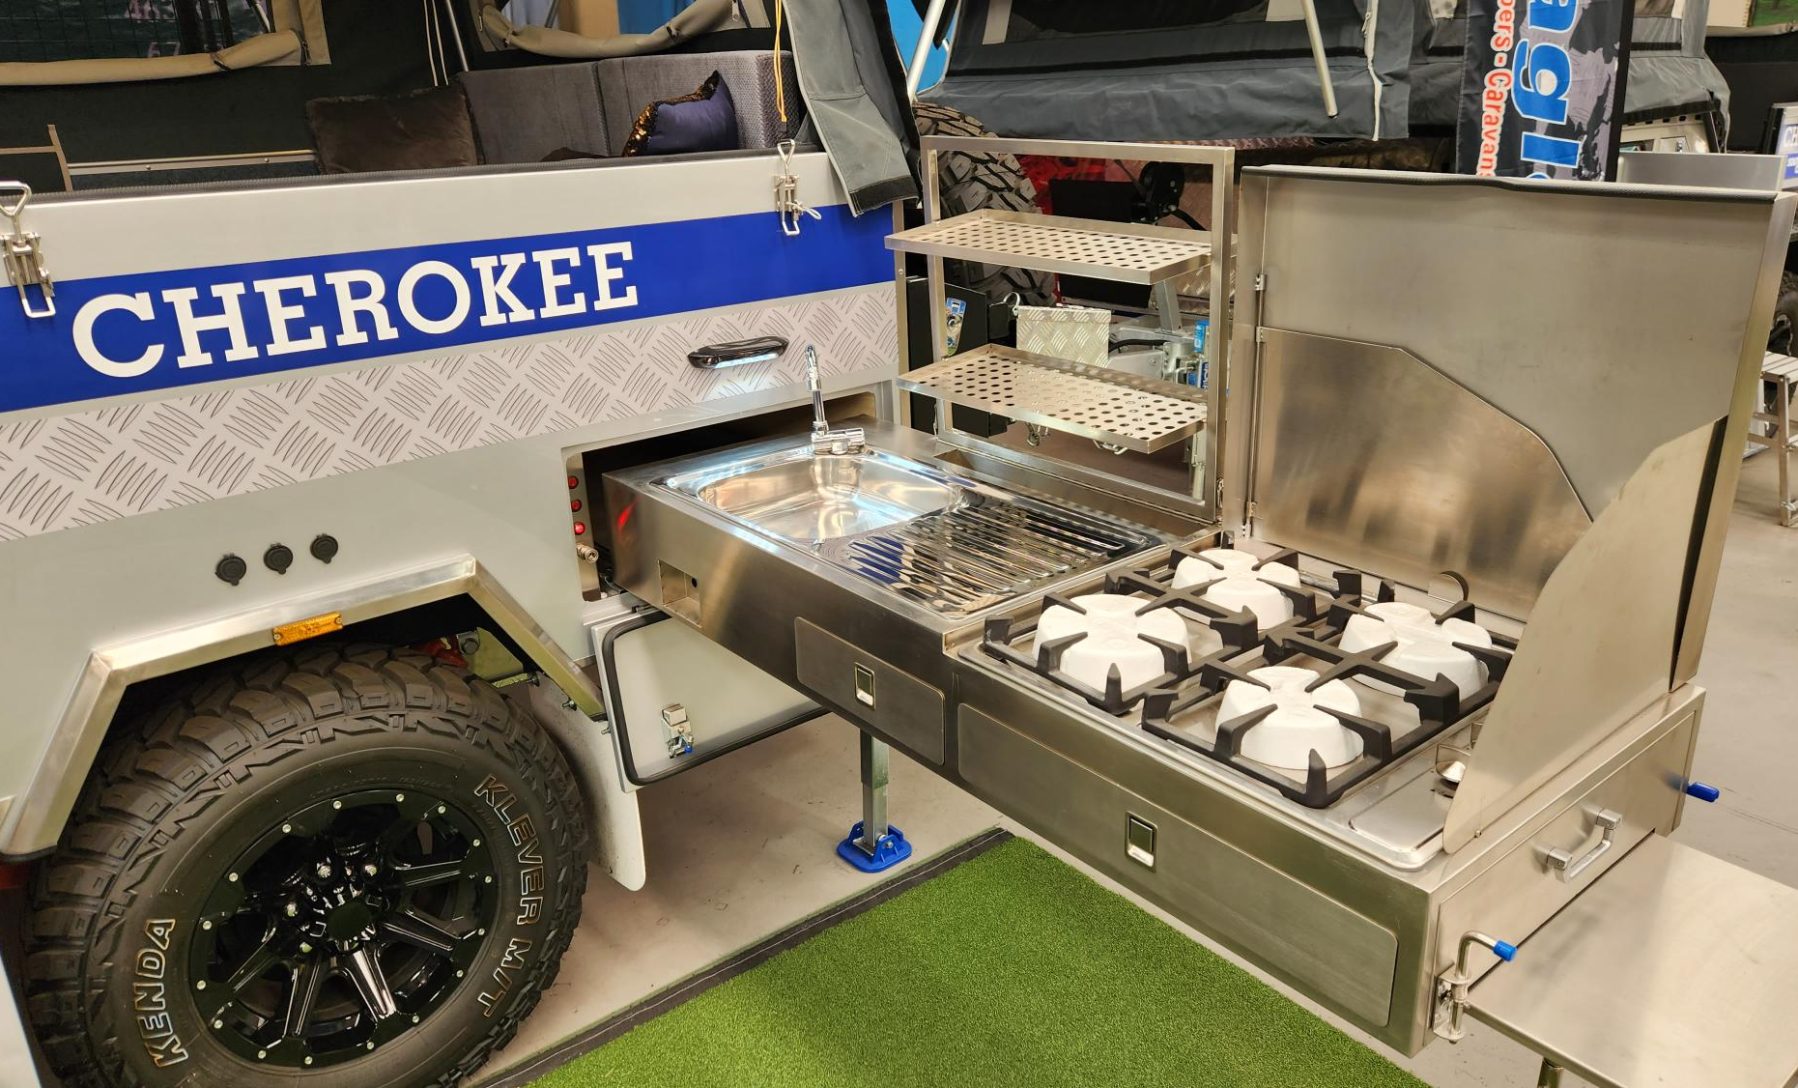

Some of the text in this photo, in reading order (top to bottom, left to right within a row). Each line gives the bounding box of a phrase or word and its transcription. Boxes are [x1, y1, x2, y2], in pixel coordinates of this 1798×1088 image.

[72, 241, 639, 378] CHEROKEE
[474, 773, 545, 1018] KLEVER M/T
[133, 919, 189, 1067] KENDA
